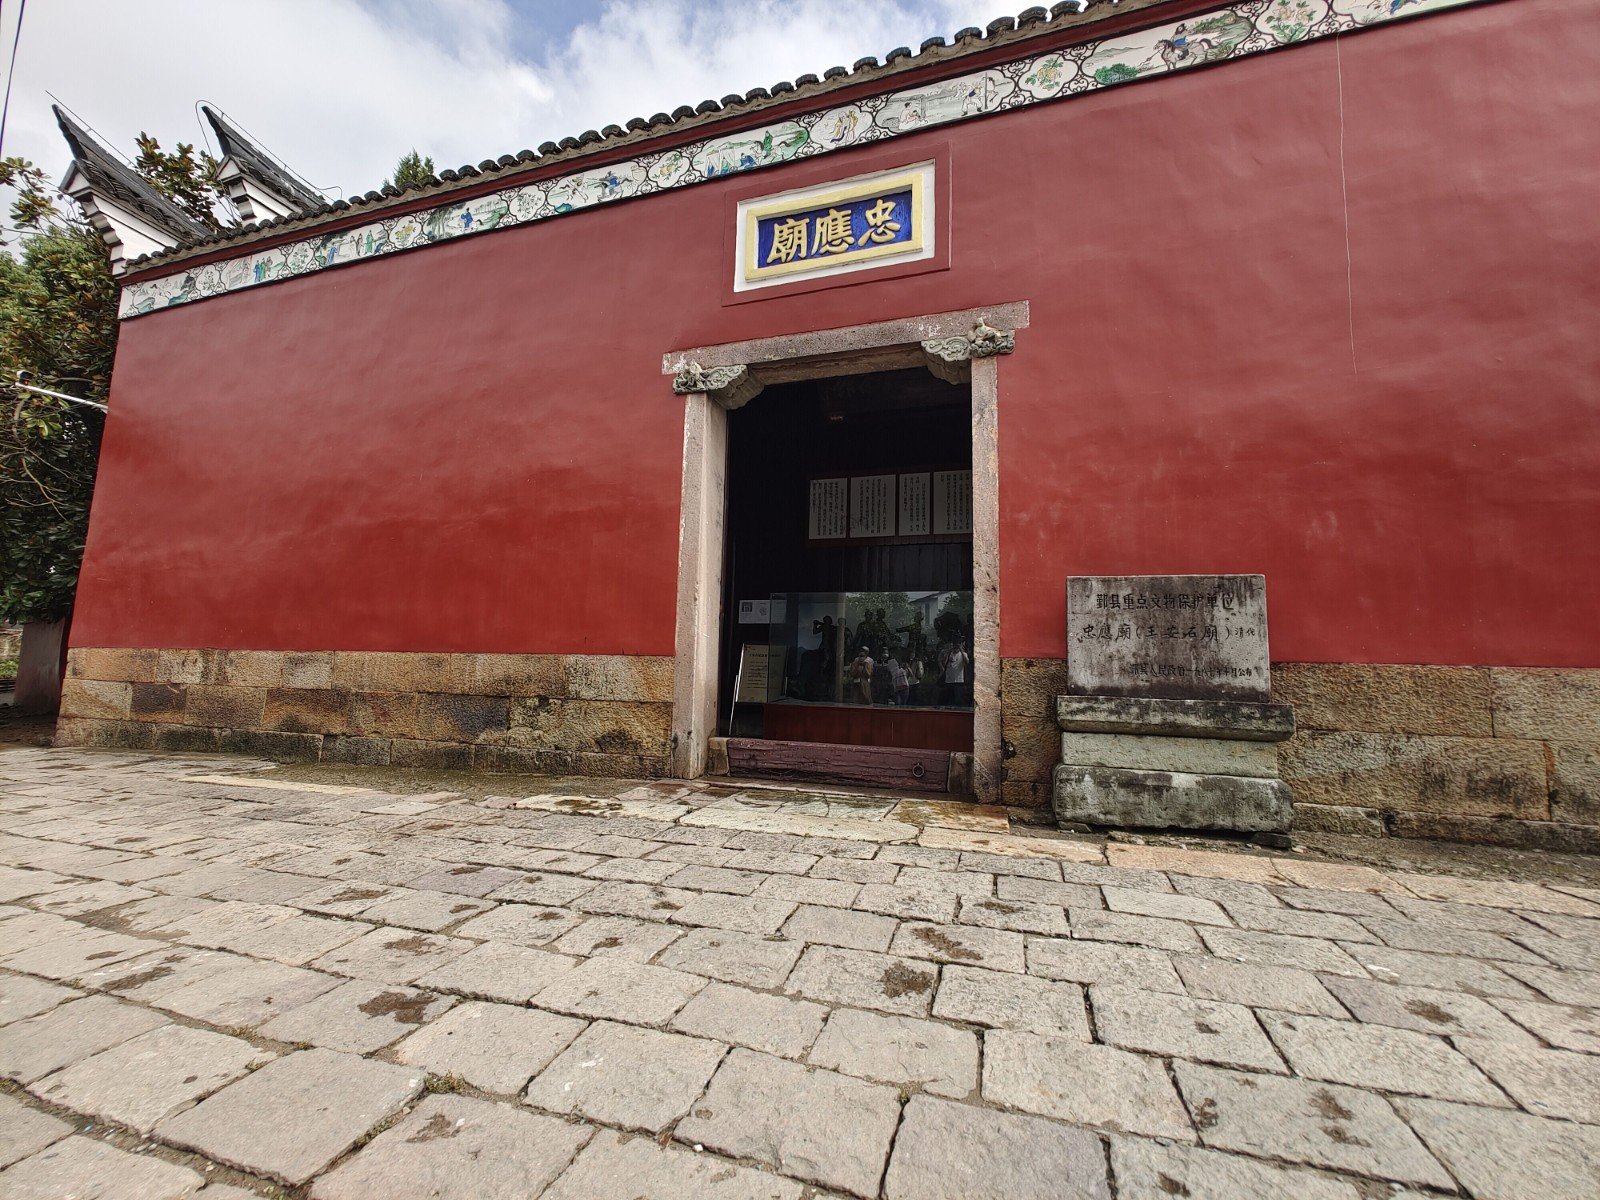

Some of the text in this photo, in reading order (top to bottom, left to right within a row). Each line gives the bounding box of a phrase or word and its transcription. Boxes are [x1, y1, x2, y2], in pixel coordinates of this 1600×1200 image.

[1097, 592, 1234, 611] 鄞县重点文物保护单位
